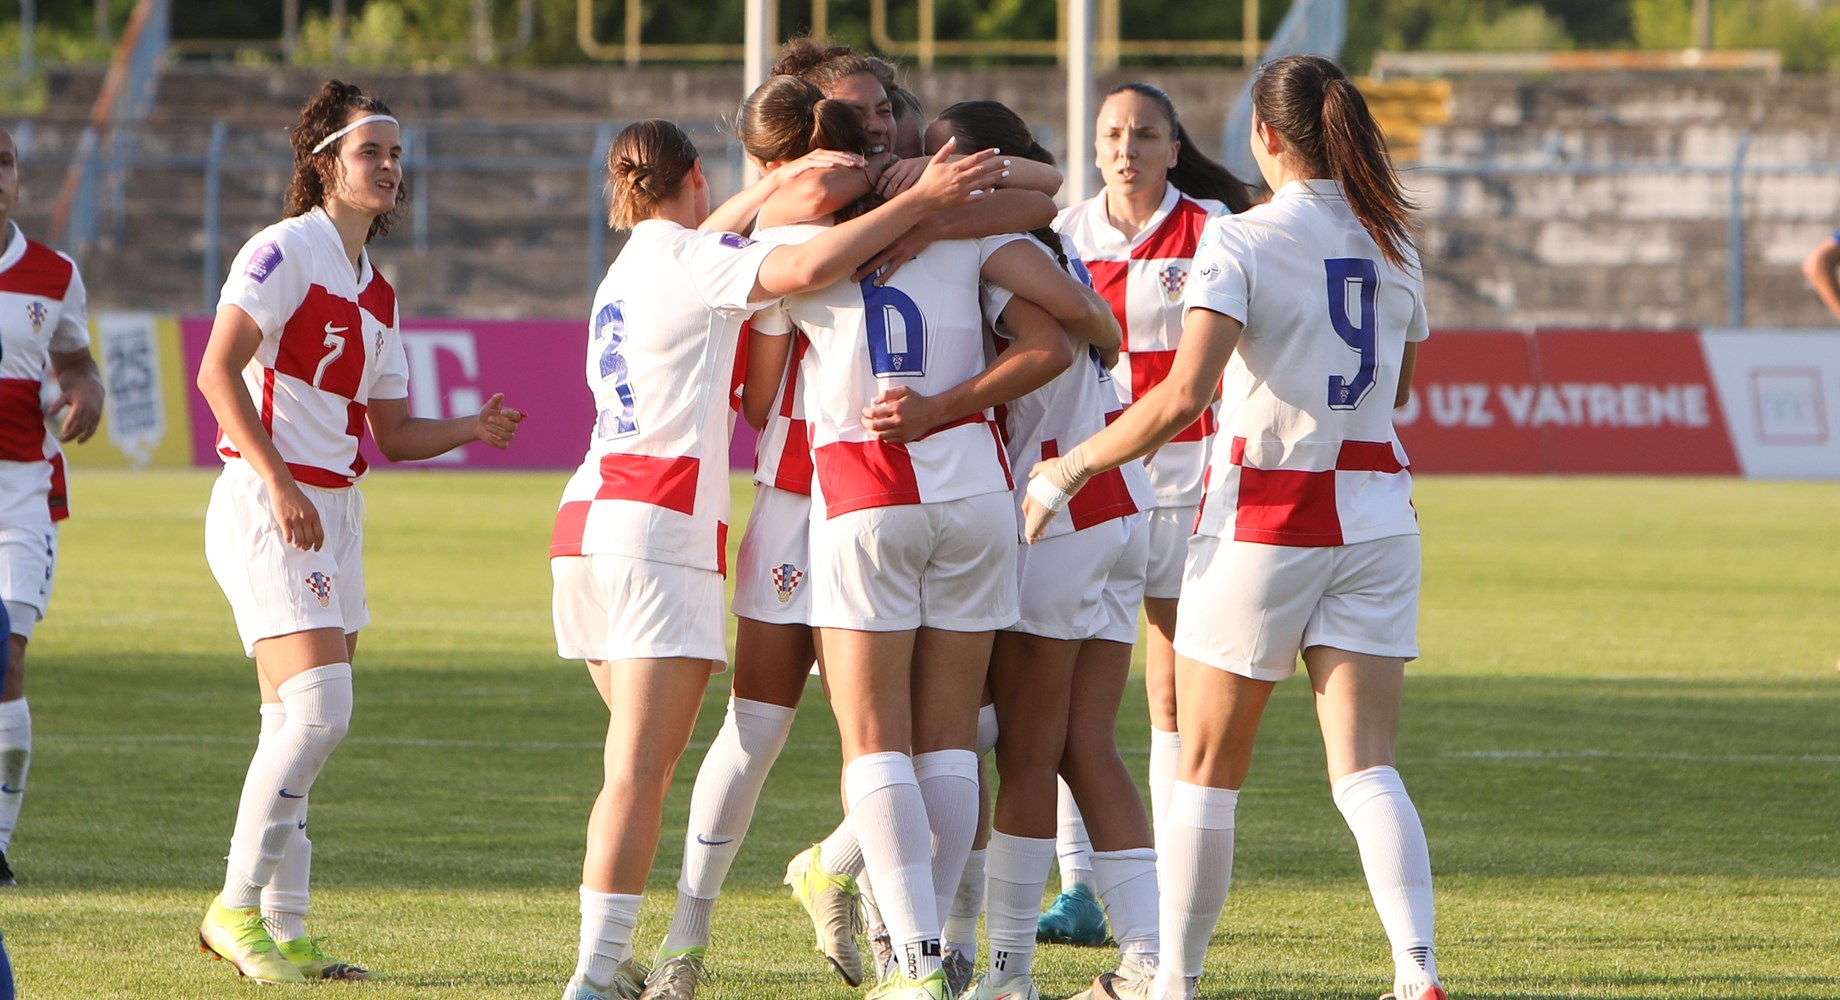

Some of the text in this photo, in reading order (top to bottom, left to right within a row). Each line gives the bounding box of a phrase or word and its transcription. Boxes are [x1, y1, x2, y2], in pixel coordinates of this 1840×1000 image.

[313, 333, 345, 390] 7
[595, 299, 640, 441] 3
[1323, 257, 1382, 412] 9
[1428, 382, 1496, 428] UZ
[1498, 382, 1711, 428] VATRENE
